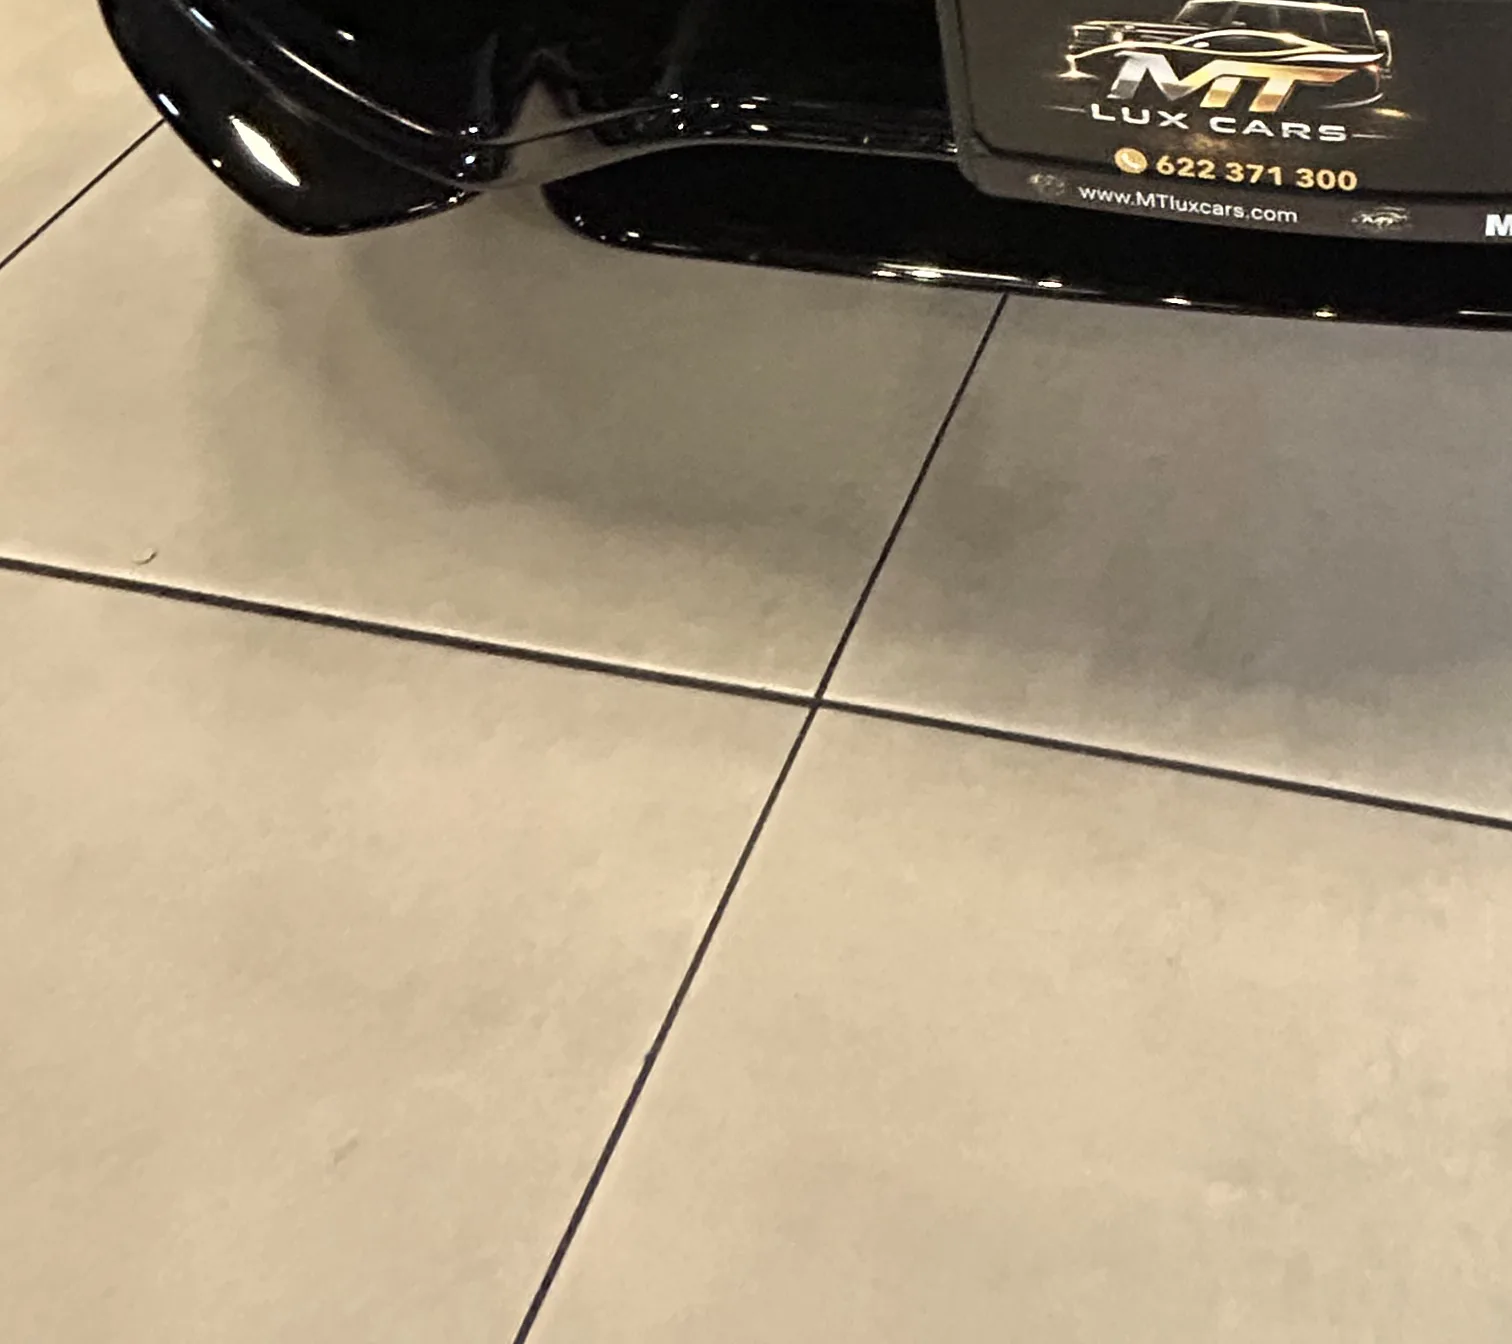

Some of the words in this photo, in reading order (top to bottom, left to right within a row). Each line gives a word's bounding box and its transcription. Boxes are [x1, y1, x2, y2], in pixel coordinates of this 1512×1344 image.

[1107, 51, 1356, 113] MT
[1090, 104, 1189, 130] LUX
[1210, 117, 1347, 142] CARS
[1156, 155, 1217, 179] 622
[1225, 161, 1282, 186] 371
[1296, 167, 1358, 192] 300
[1079, 186, 1298, 223] www.MTluxcars.com
